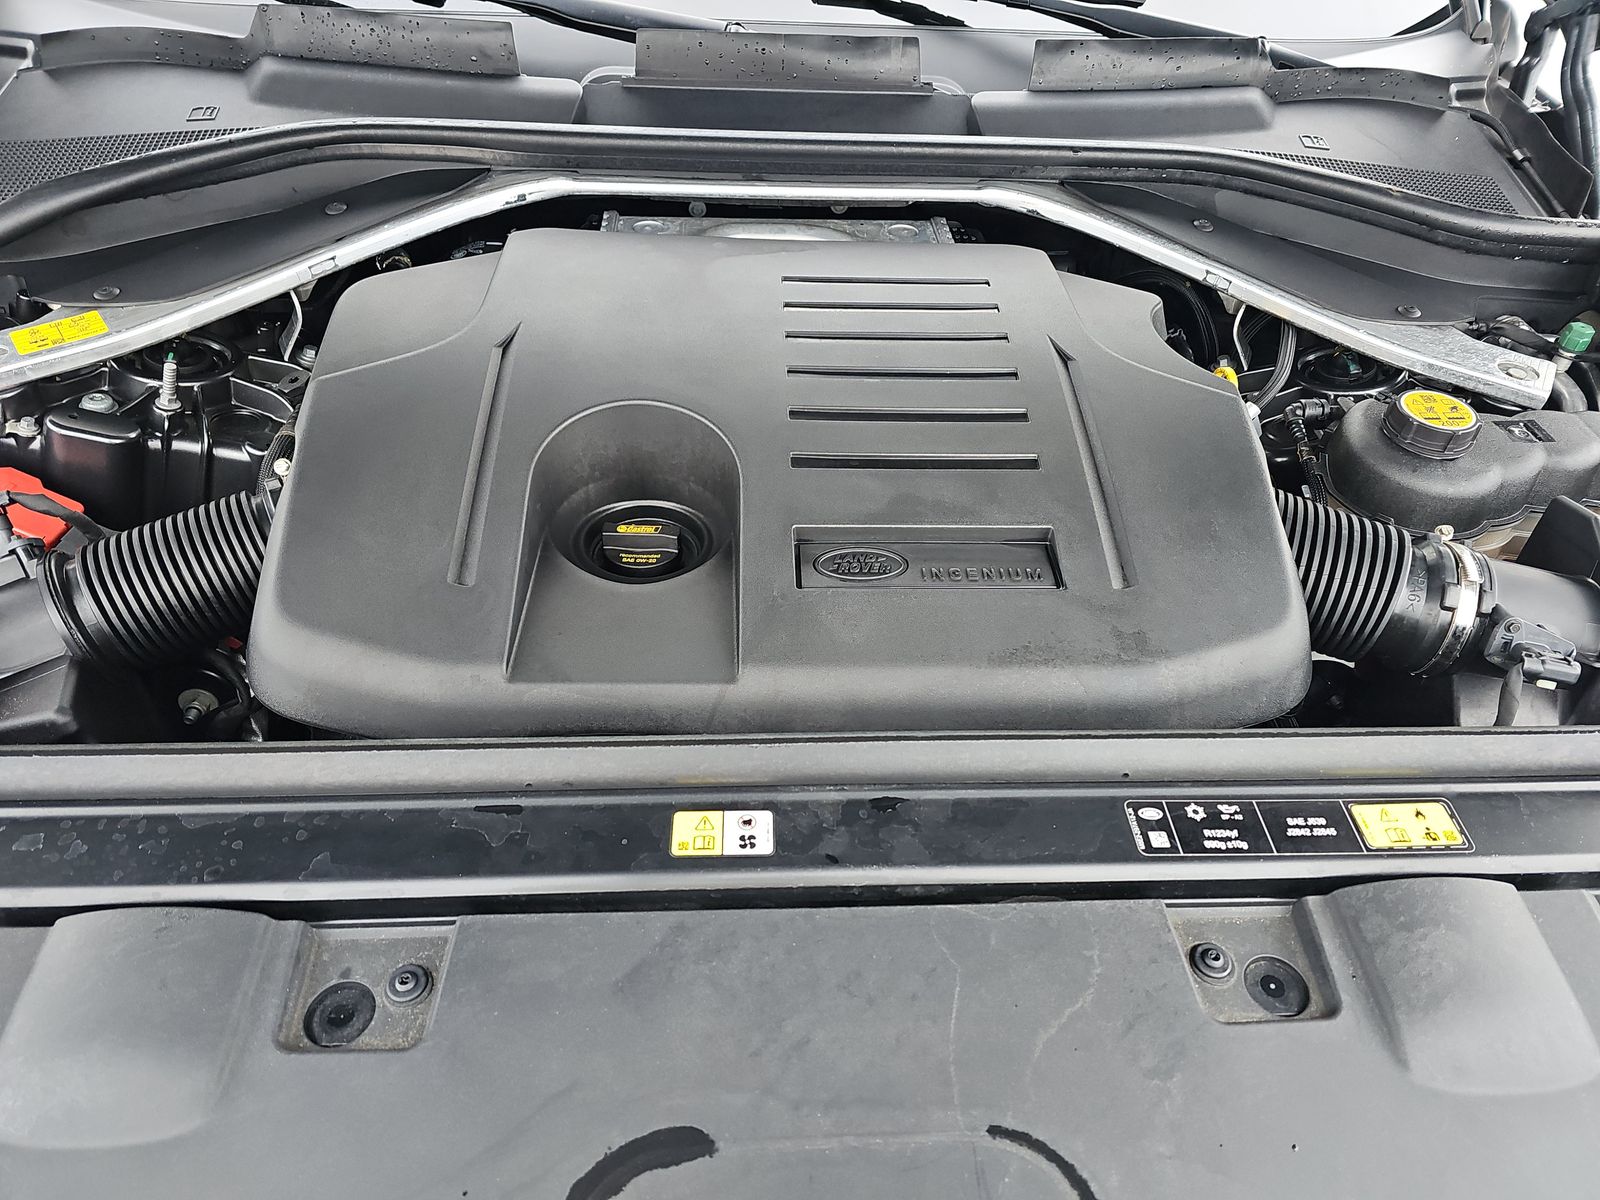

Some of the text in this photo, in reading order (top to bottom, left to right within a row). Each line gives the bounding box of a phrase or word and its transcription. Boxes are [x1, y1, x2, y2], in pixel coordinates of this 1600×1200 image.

[833, 554, 877, 563] LAND
[837, 563, 891, 573] ROVER
[920, 566, 1044, 582] INGENIUM
[1286, 817, 1306, 825] SAE
[1203, 829, 1239, 839] R1234yf
